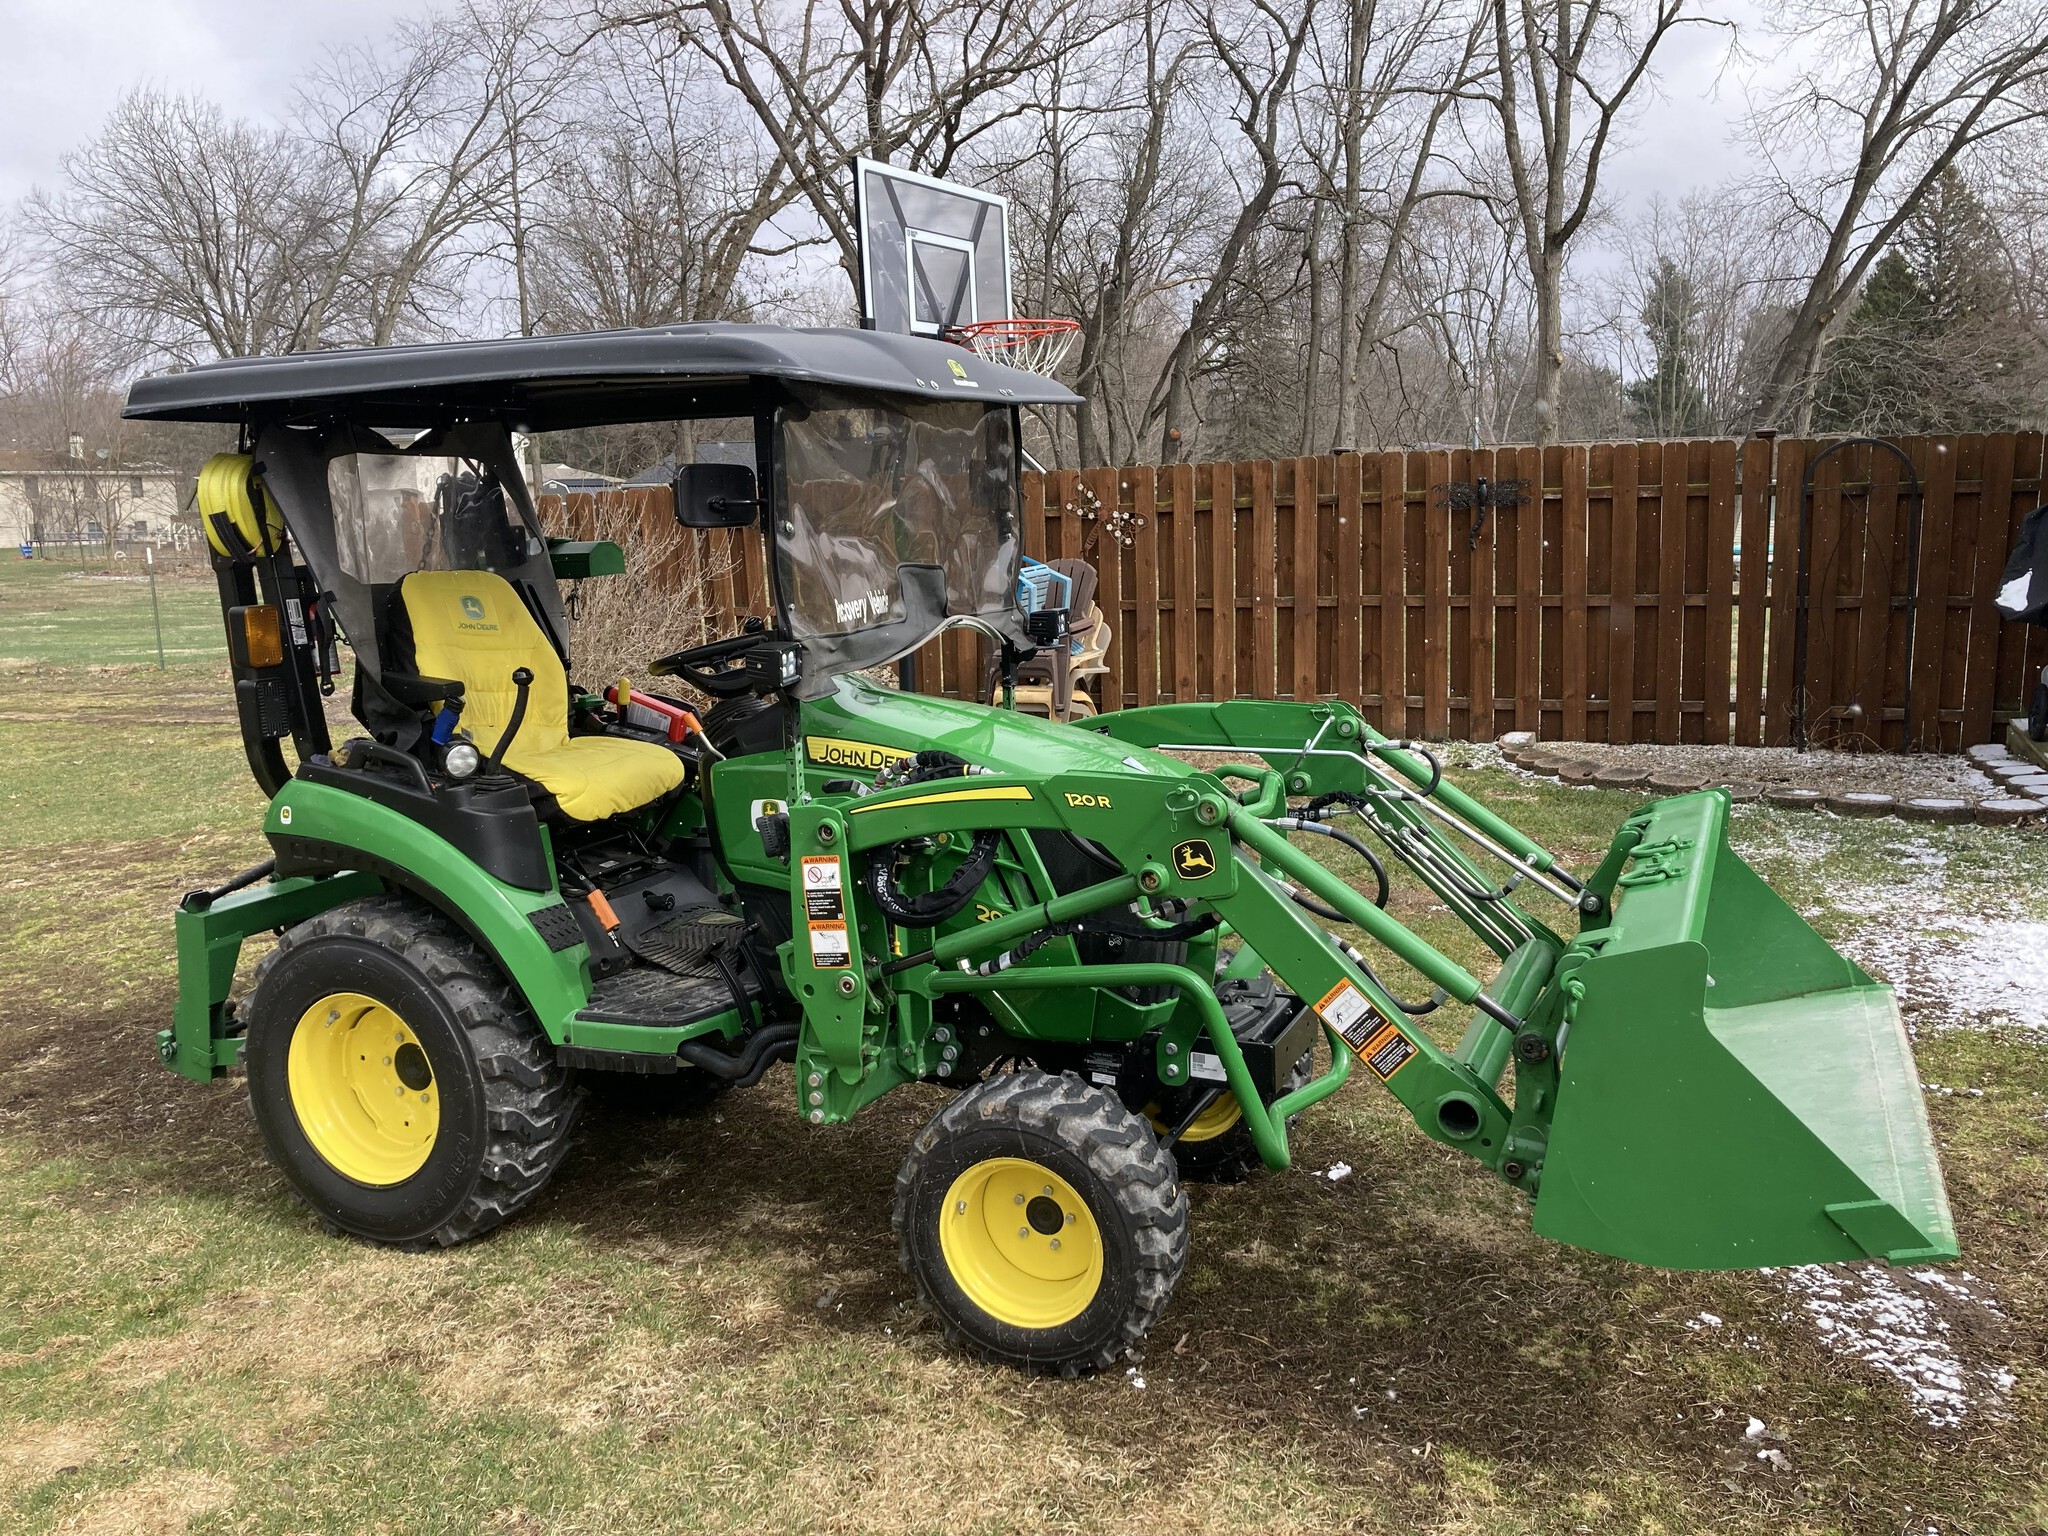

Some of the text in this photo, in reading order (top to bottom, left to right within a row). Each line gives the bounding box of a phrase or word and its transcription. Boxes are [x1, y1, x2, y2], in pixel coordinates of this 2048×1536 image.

[458, 621, 476, 630] JOHN
[819, 744, 866, 766] JOHN
[1063, 792, 1113, 809] 120 R
[809, 855, 838, 863] WARNING
[816, 922, 845, 931] WARNING
[1324, 982, 1347, 1004] WARNING
[1371, 1030, 1395, 1052] WARNING
